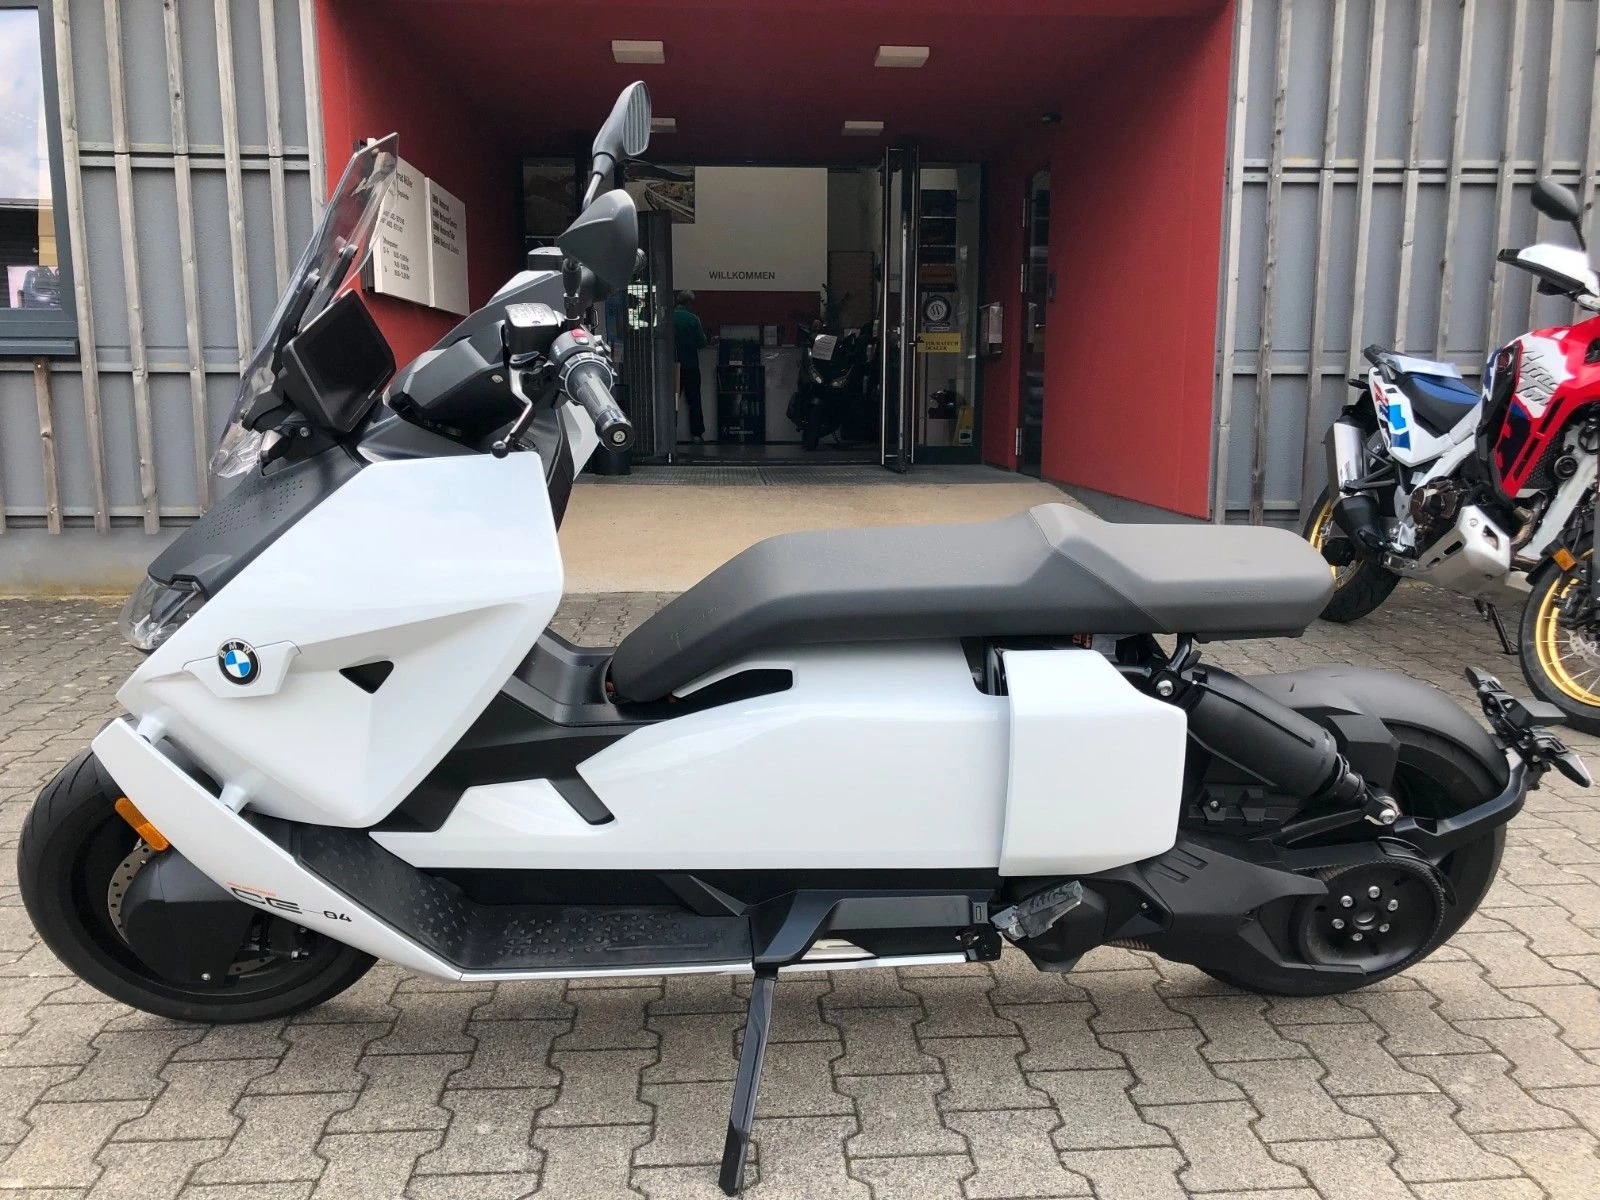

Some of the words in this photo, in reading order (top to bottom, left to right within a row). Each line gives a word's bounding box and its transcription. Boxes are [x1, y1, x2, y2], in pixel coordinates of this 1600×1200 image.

[708, 271, 776, 281] WILLKOMMEN
[219, 642, 252, 659] BMW
[230, 887, 303, 915] CE
[323, 910, 352, 923] 04
